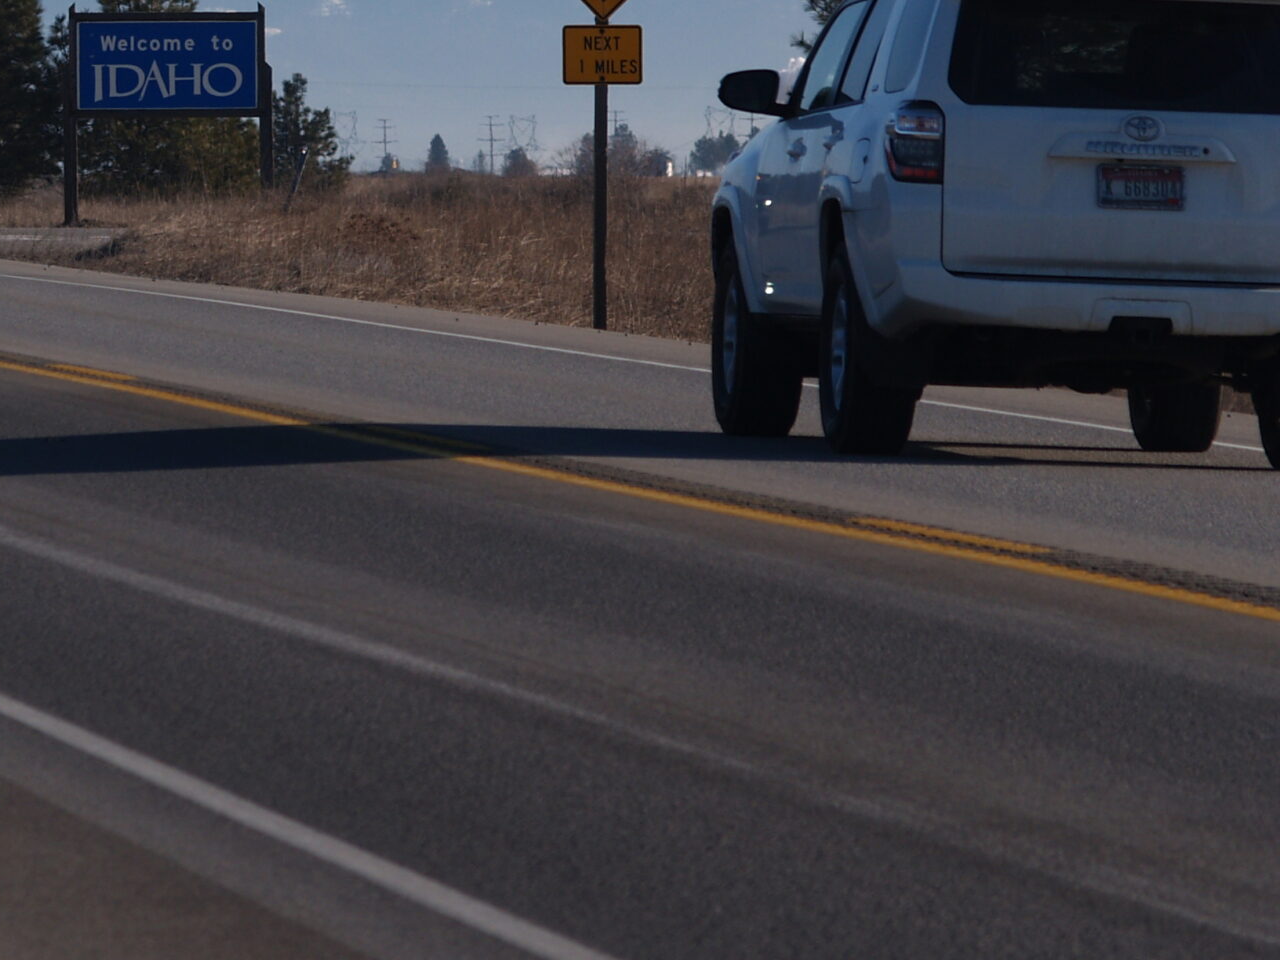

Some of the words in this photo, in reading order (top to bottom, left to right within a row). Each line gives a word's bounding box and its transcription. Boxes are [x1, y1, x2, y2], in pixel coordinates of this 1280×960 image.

[100, 35, 196, 51] Welcome
[211, 35, 233, 50] to
[584, 36, 620, 51] NEXT
[579, 59, 585, 73] 1
[595, 59, 638, 74] MILES
[91, 59, 243, 103] IDAHO
